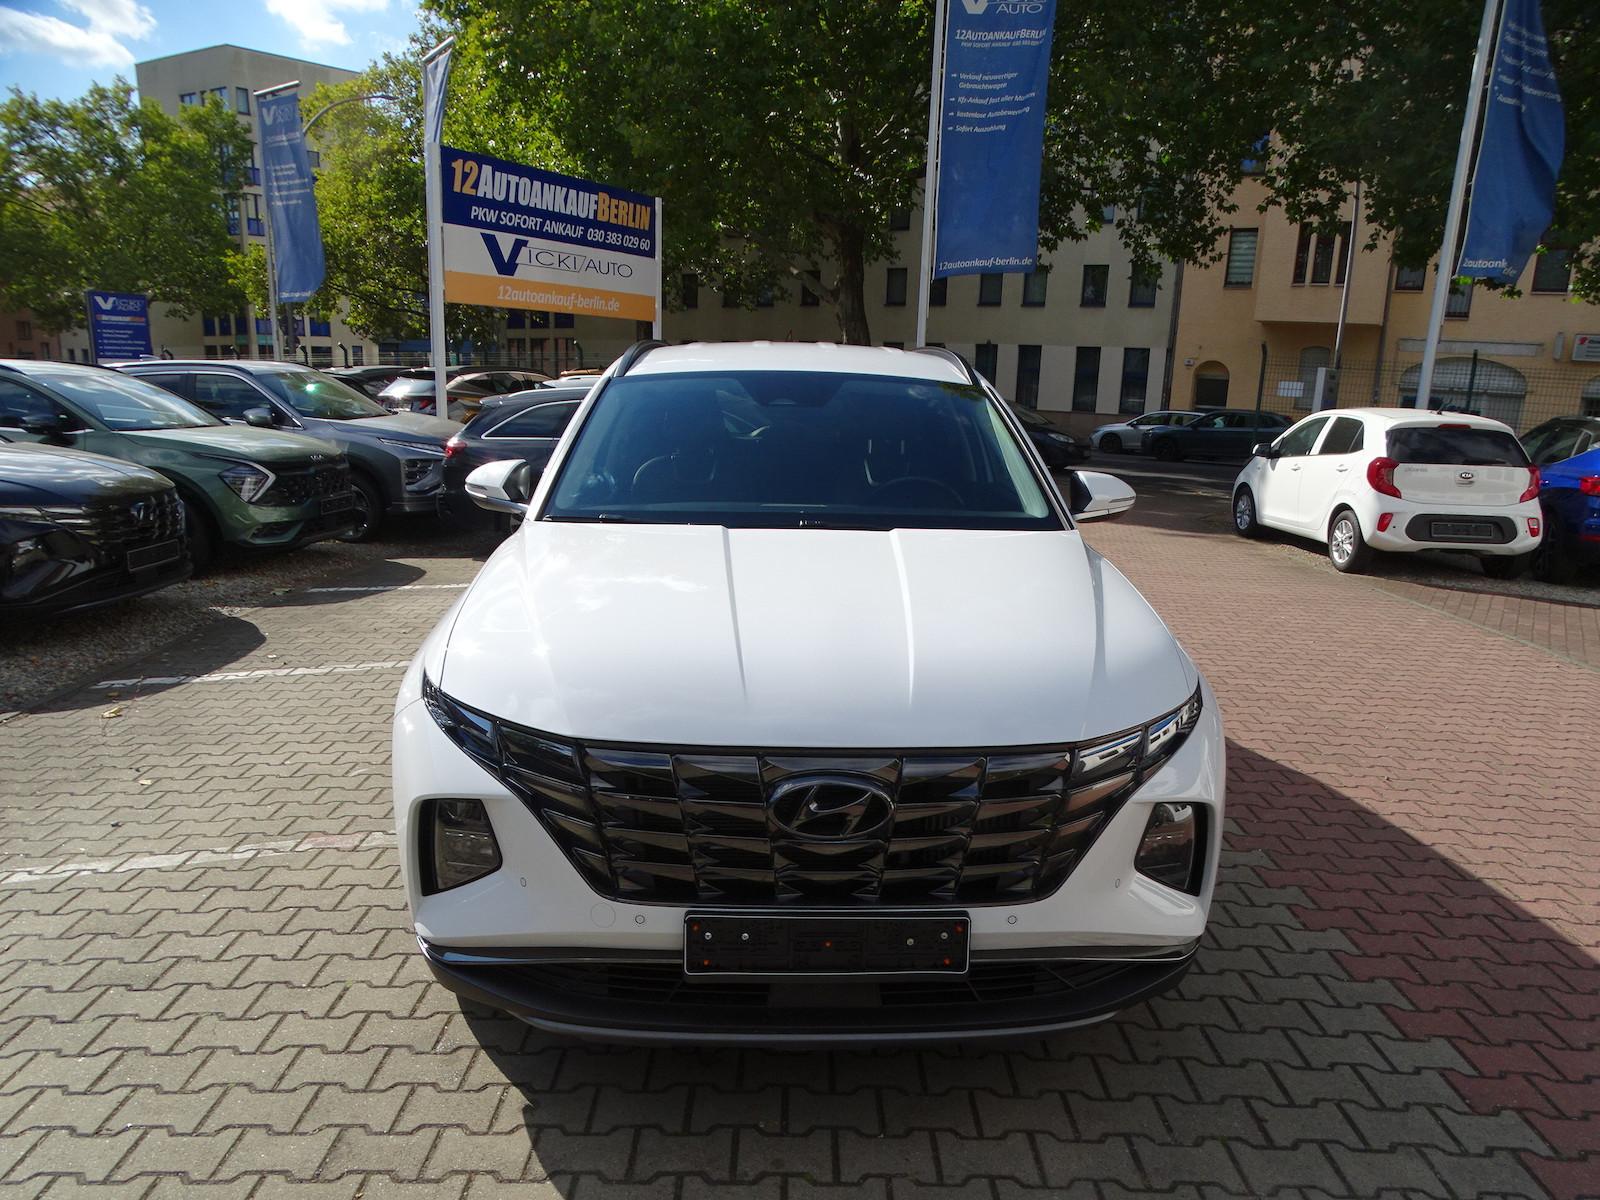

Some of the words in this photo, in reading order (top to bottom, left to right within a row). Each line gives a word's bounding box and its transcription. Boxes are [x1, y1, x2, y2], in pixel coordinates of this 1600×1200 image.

[996, 3, 1043, 14] AUTO
[470, 205, 498, 223] PKW
[499, 211, 543, 231] SOFORT
[543, 220, 585, 239] ANKAUF
[587, 228, 605, 242] 030
[605, 231, 622, 246] 383
[623, 235, 639, 249] 029
[639, 238, 651, 251] 60
[585, 258, 633, 278] AUTO
[938, 257, 1033, 271] 12autoankauf-berlin.de
[497, 285, 620, 312] 12autoankauf-berlin.de
